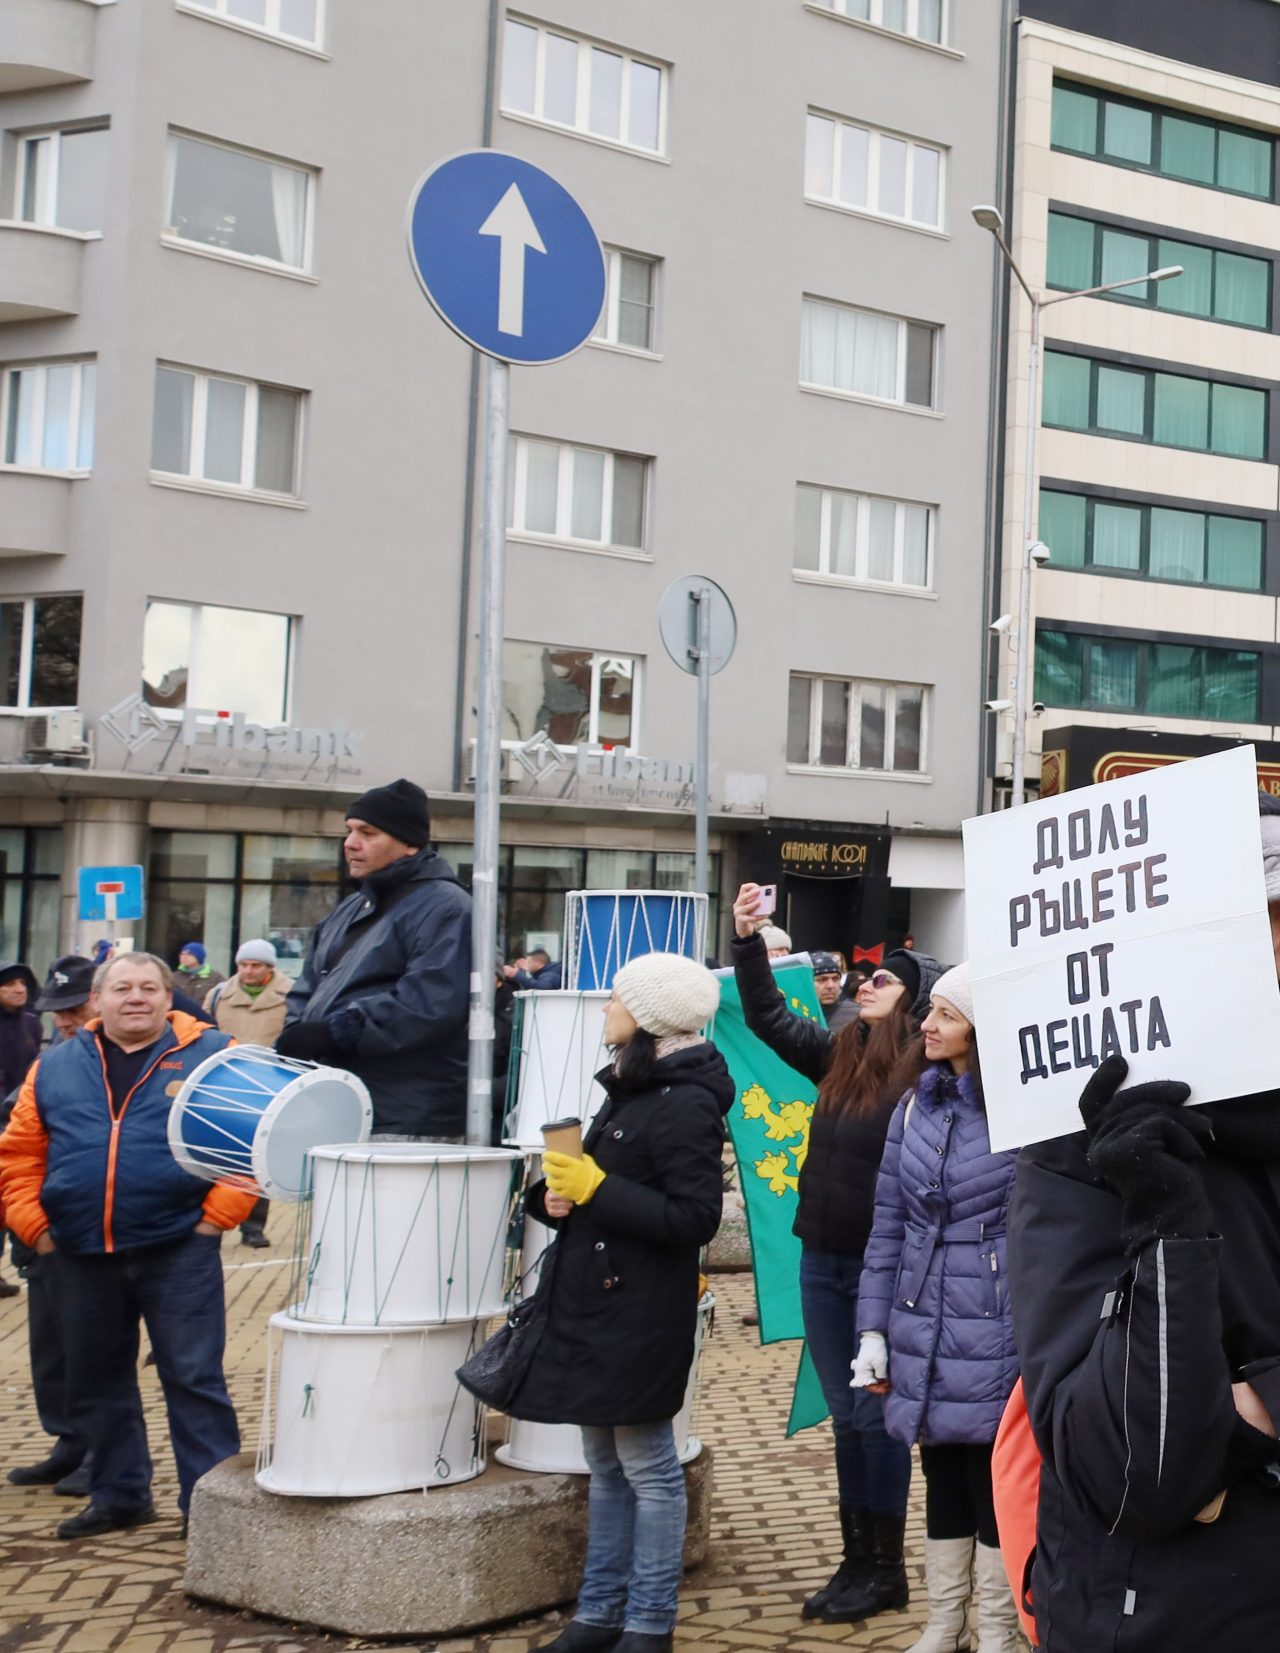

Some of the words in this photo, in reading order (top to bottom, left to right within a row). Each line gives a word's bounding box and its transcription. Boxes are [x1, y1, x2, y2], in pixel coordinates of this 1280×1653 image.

[183, 707, 366, 758] Fibank
[1032, 794, 1149, 875] ДОЛУ
[1009, 853, 1169, 948] РЪЦЕТЕ
[1066, 942, 1114, 1006] ОТ
[1018, 995, 1172, 1086] ДЕЦАТА
